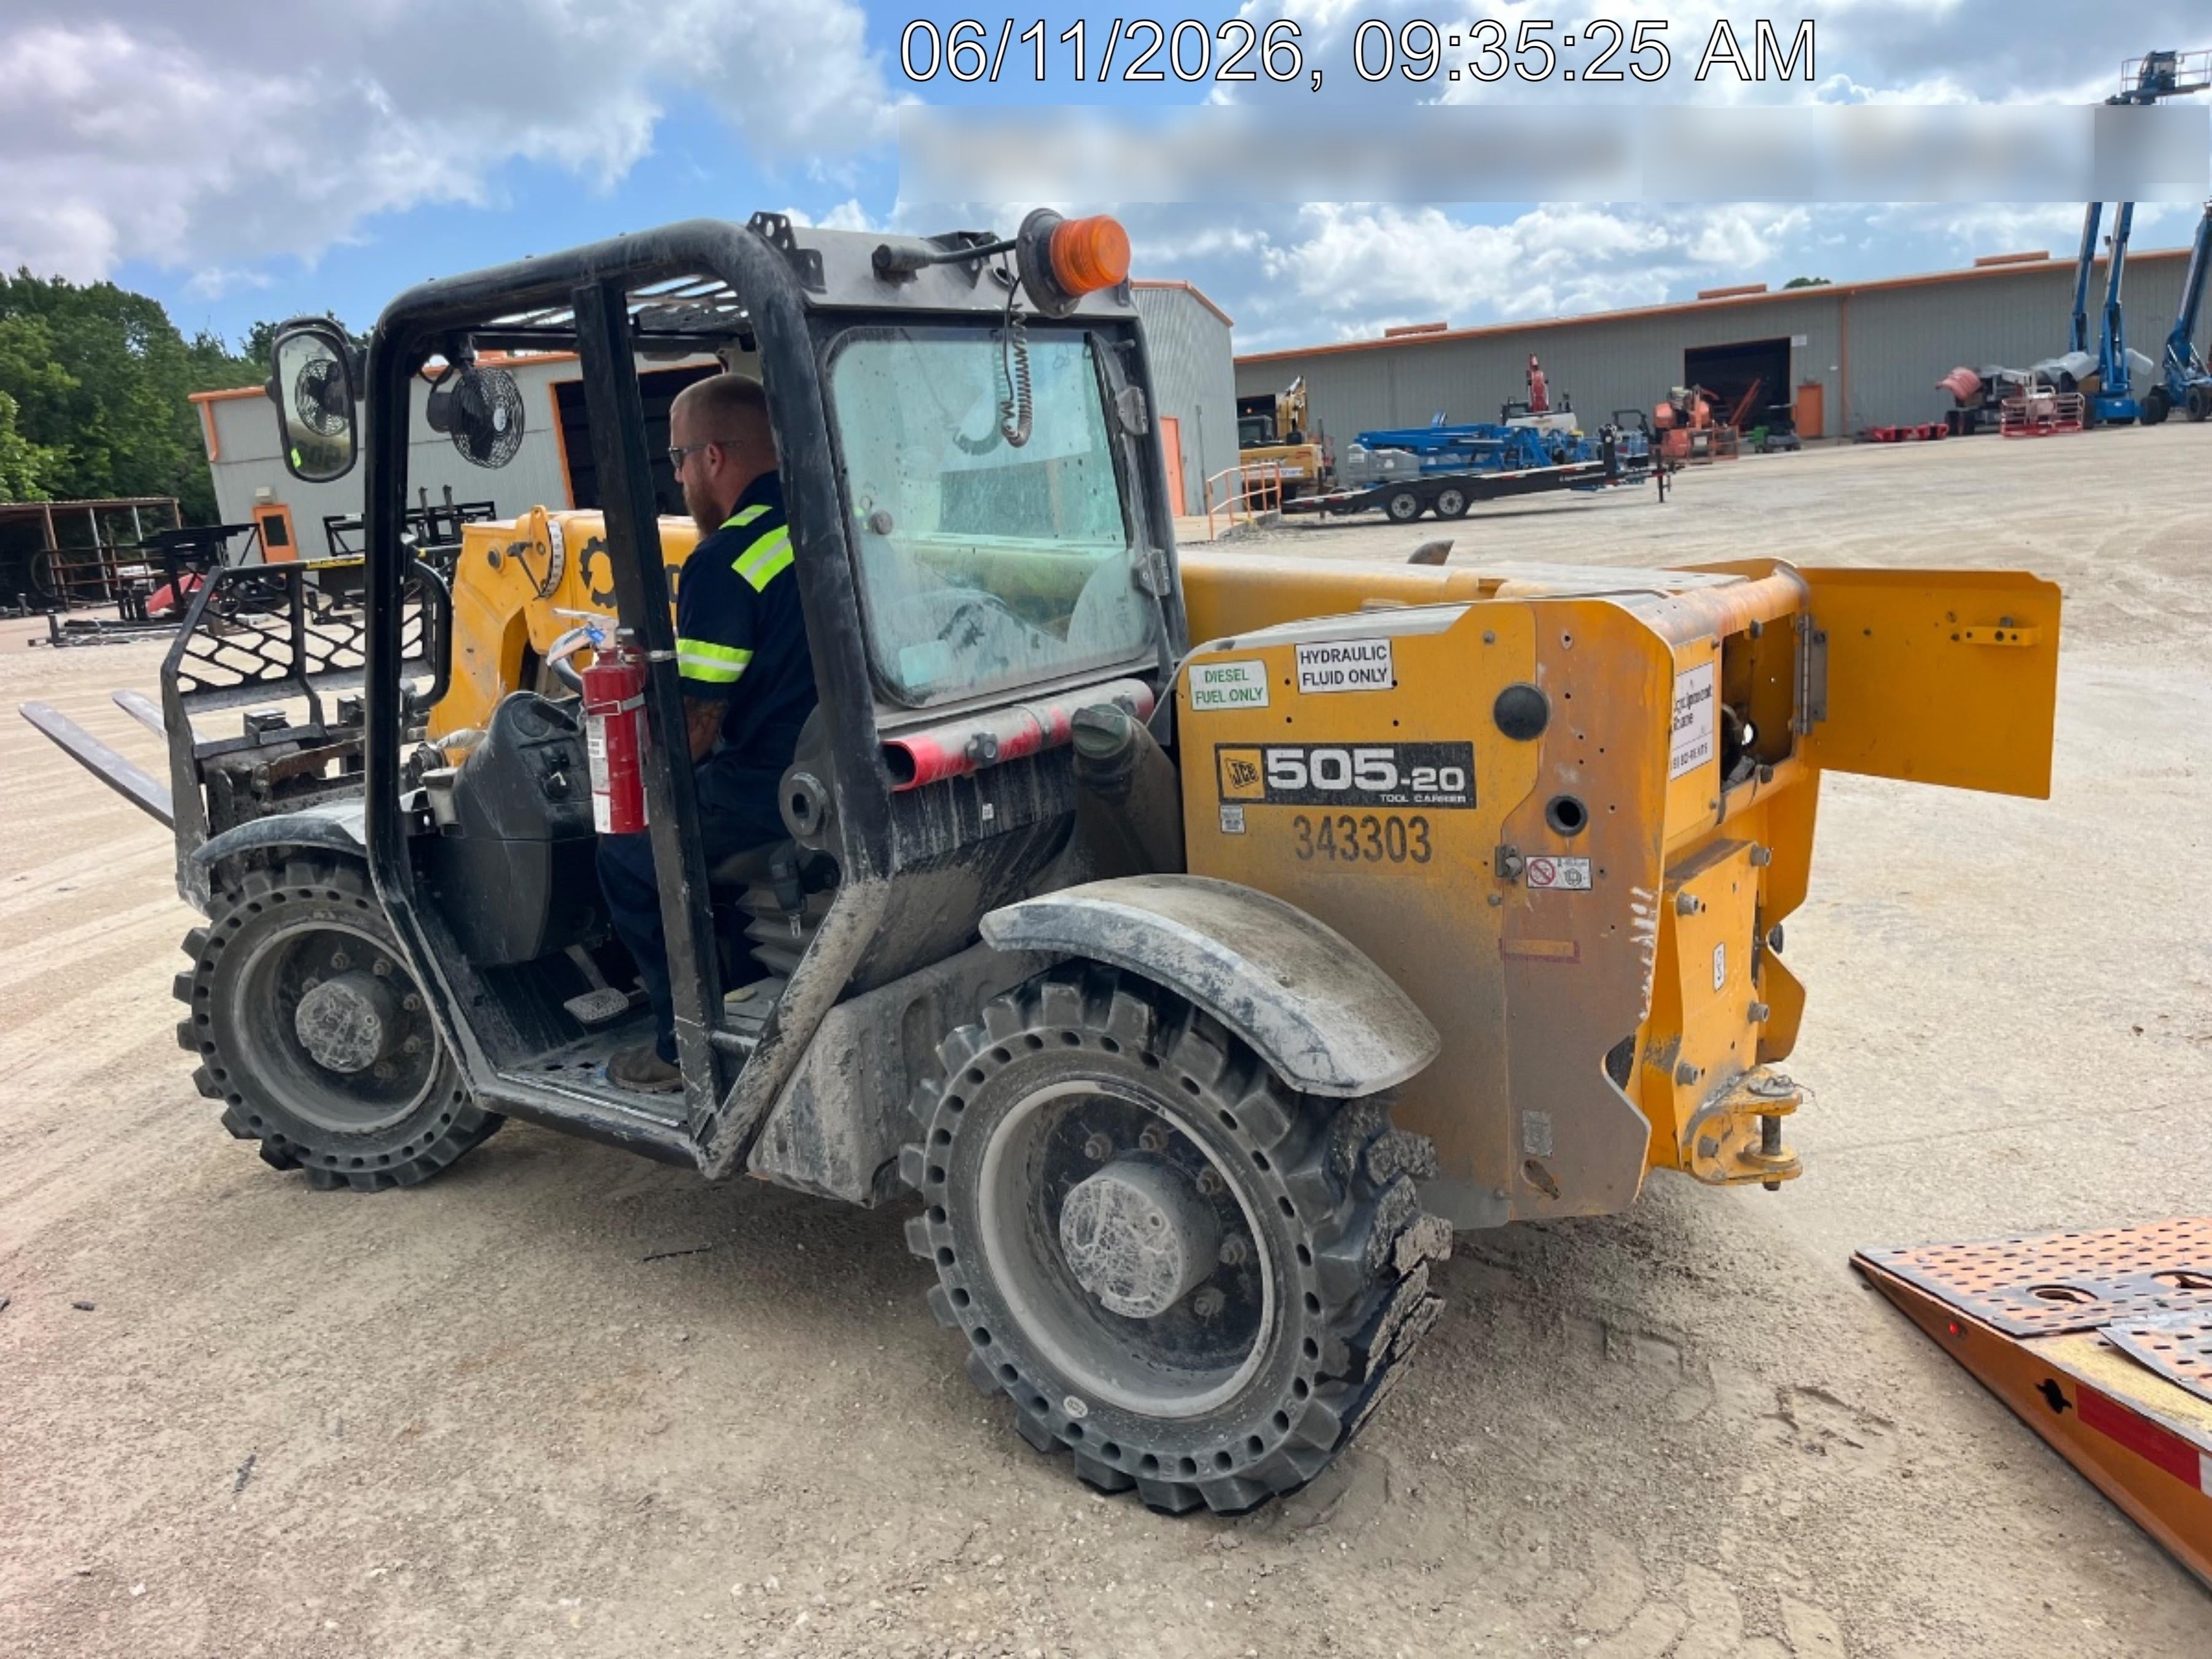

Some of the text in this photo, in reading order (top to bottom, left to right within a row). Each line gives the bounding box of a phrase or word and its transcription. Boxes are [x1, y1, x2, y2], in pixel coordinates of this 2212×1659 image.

[1300, 646, 1387, 664] HYDRAULIC
[1205, 669, 1249, 683] DIESEL
[1303, 667, 1387, 686] FLUID ONLY
[1195, 687, 1263, 704] FUEL ONLY
[1231, 763, 1257, 785] JCB
[1266, 748, 1465, 791] 505-20
[1380, 794, 1409, 803] TOOL
[1293, 815, 1432, 862] 343303
